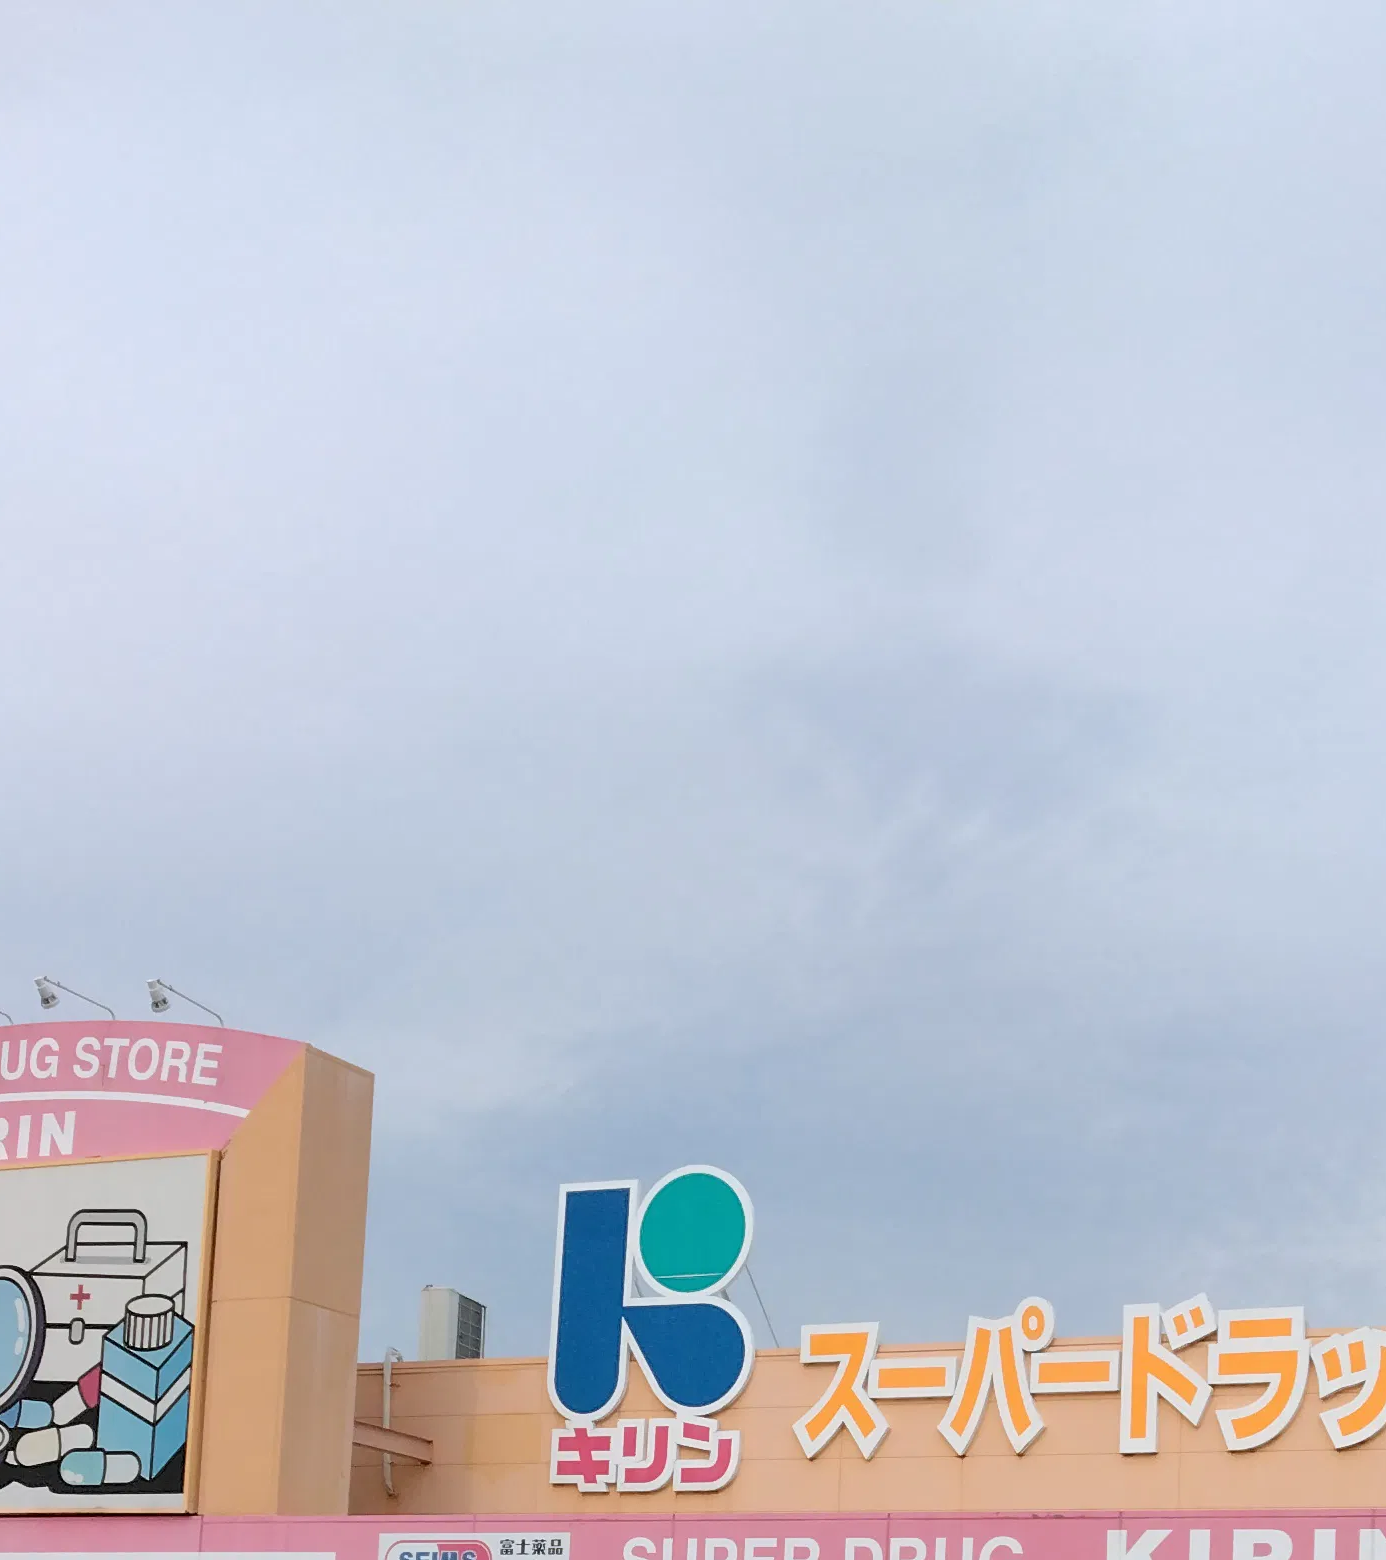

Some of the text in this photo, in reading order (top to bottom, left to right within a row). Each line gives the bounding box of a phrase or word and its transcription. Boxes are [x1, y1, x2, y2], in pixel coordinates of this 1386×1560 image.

[72, 1036, 224, 1088] STORE
[549, 1418, 741, 1493] キリン
[499, 1539, 563, 1556] 富士薬品
